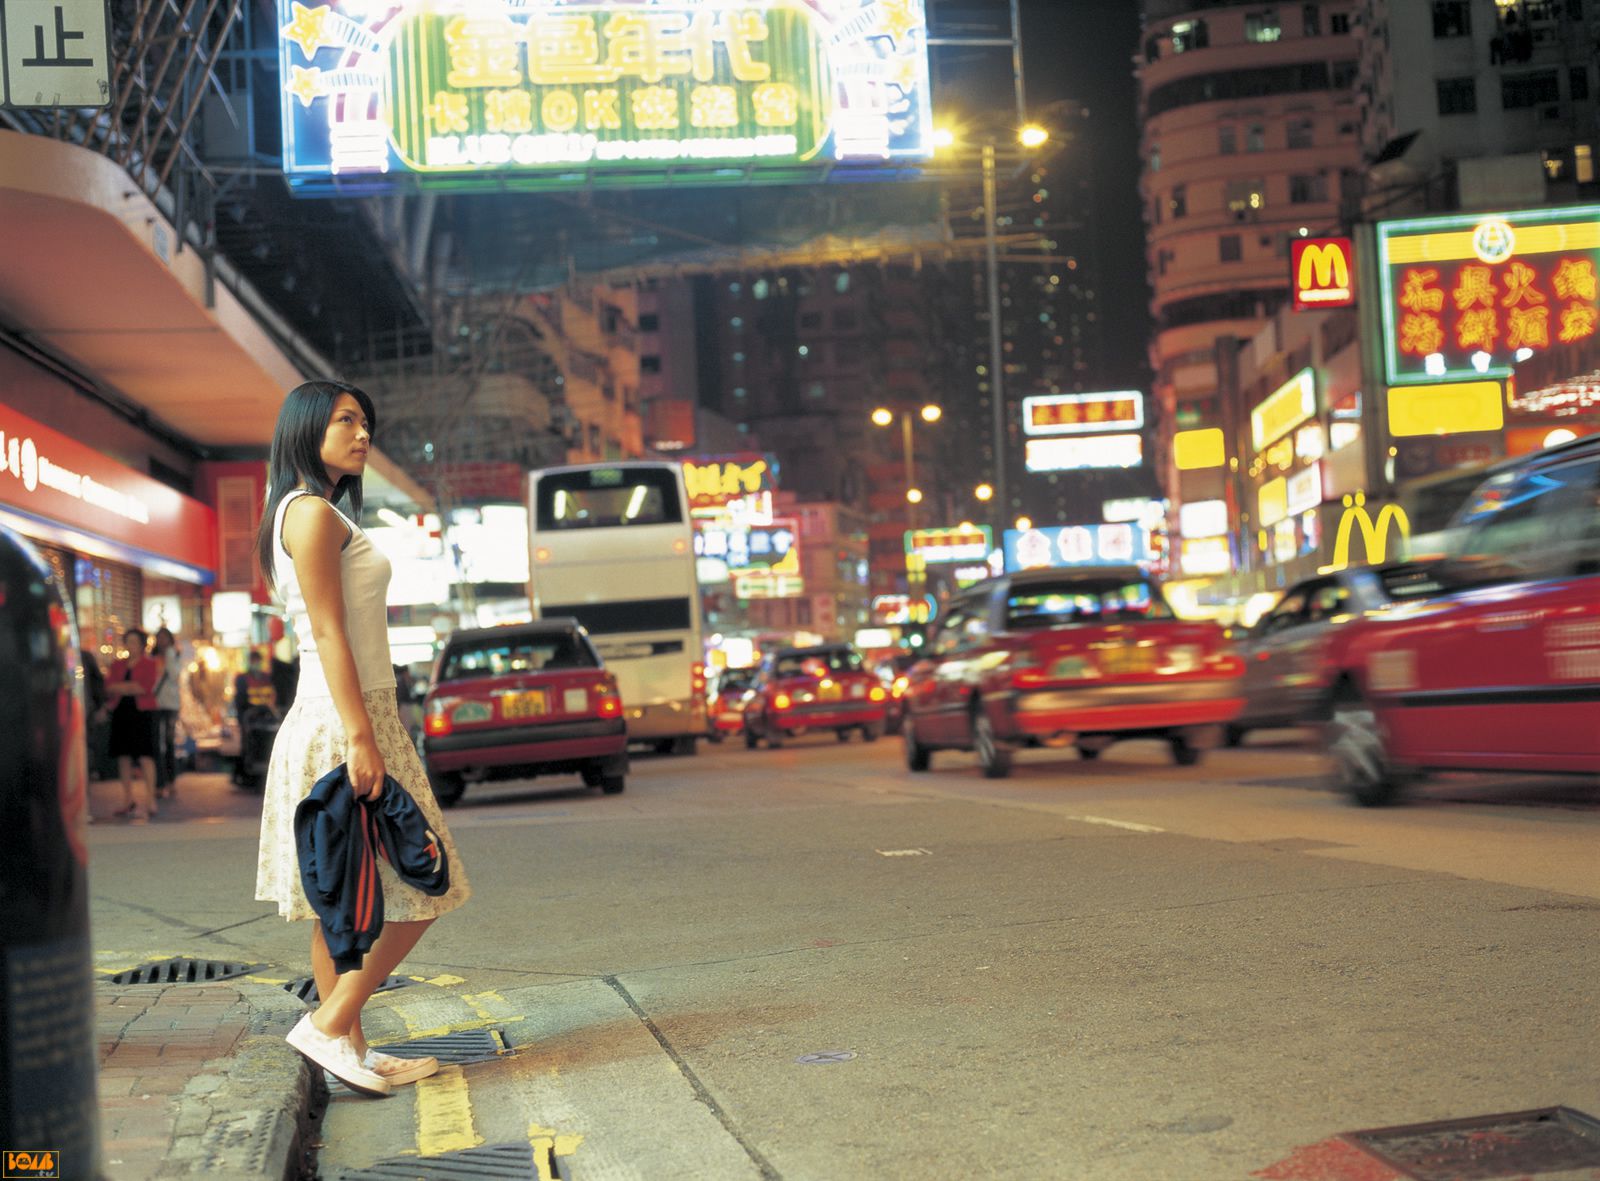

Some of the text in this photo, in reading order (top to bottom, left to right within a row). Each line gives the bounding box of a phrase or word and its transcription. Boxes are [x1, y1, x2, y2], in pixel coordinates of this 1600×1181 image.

[22, 6, 94, 67] 止
[442, 9, 771, 88] 金色年代
